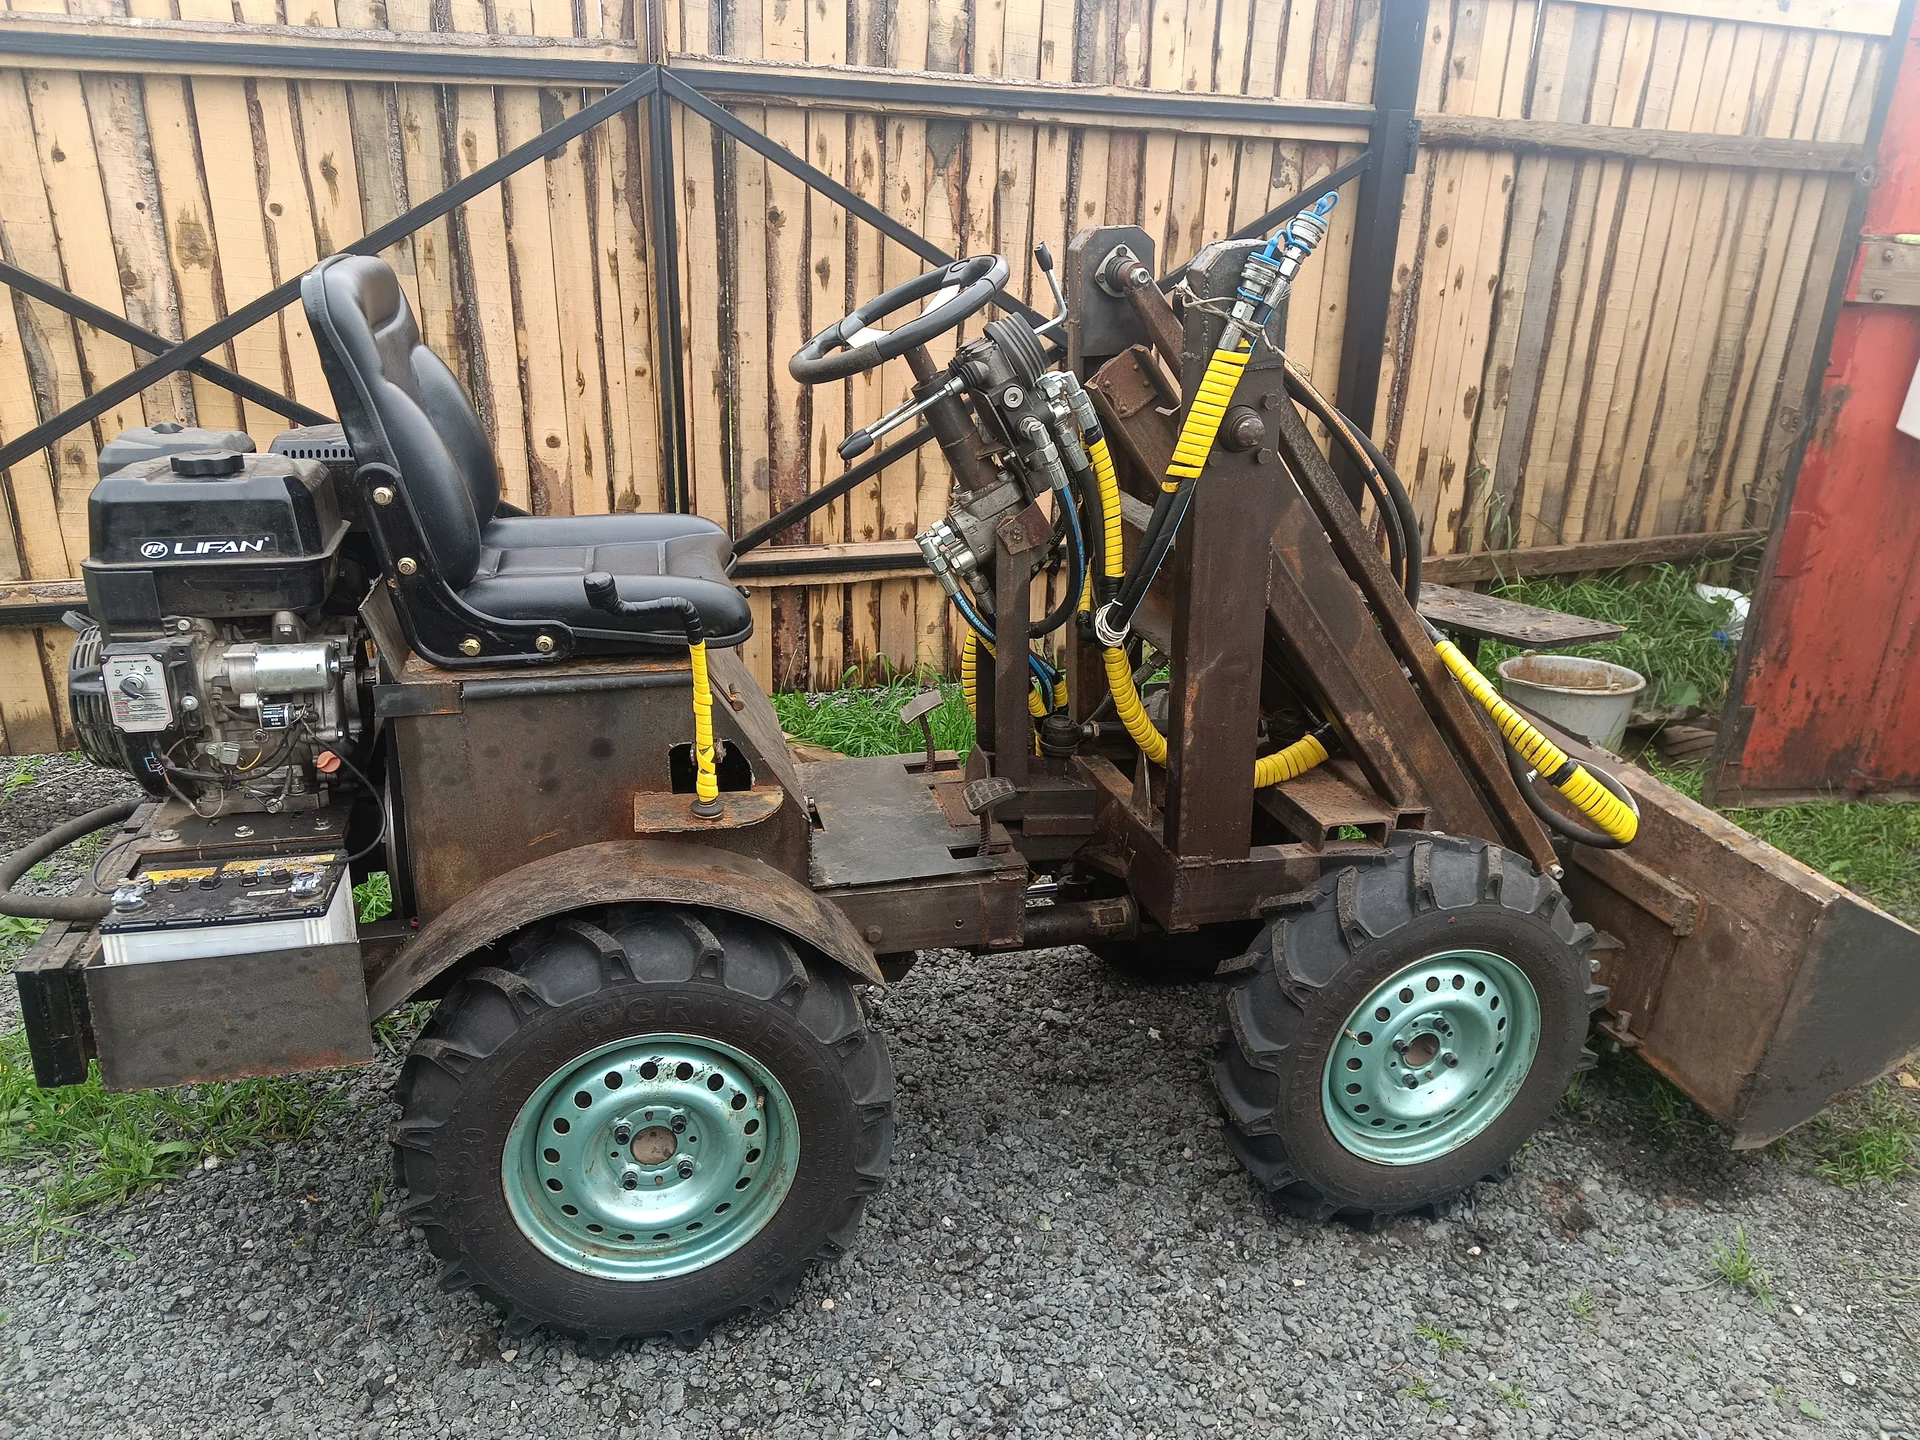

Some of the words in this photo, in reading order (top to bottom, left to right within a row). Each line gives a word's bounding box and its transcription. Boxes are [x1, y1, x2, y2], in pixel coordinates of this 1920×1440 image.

[173, 539, 264, 555] LIFAN
[629, 995, 824, 1093] GRUBERG
[1292, 951, 1395, 1114] GRUBERG
